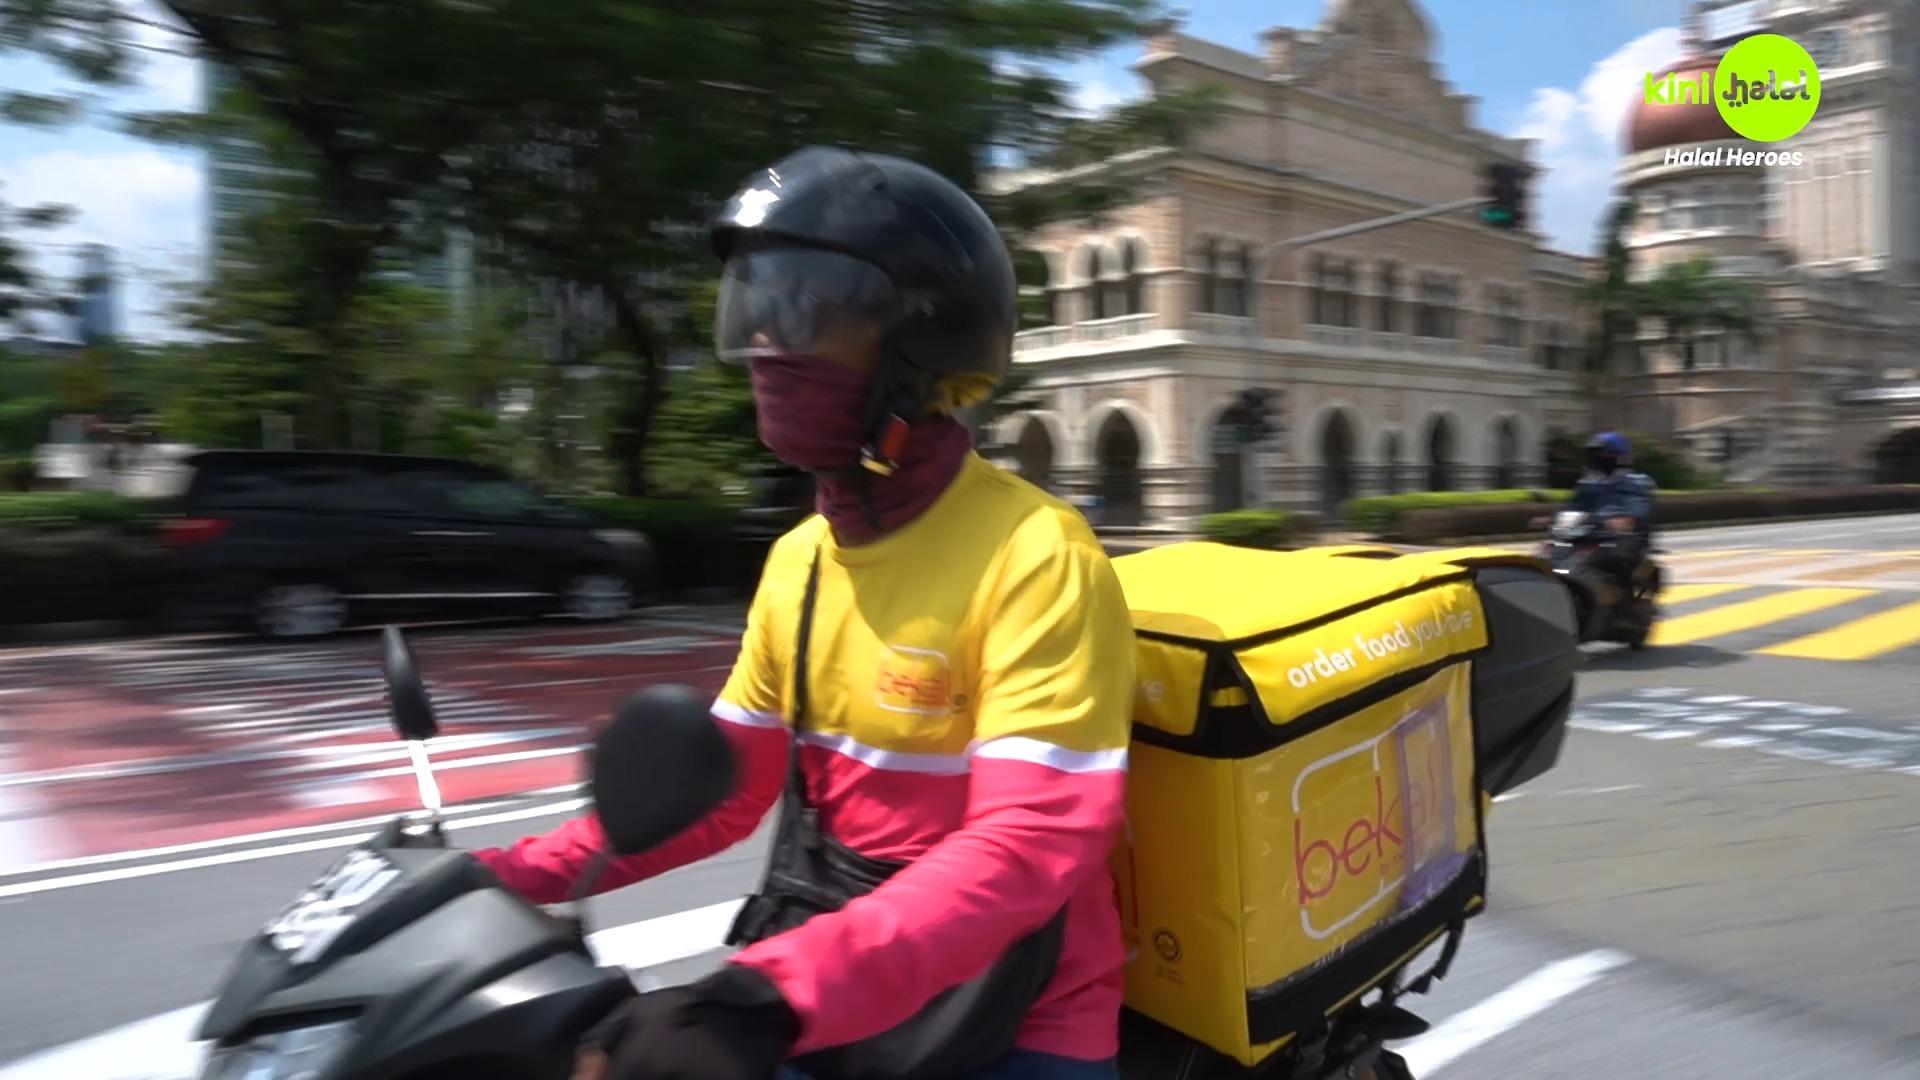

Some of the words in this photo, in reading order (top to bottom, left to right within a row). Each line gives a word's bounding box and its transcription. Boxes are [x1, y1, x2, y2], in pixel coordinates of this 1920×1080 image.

[1287, 648, 1358, 688] order
[1354, 620, 1412, 662] food
[1408, 620, 1443, 652] you
